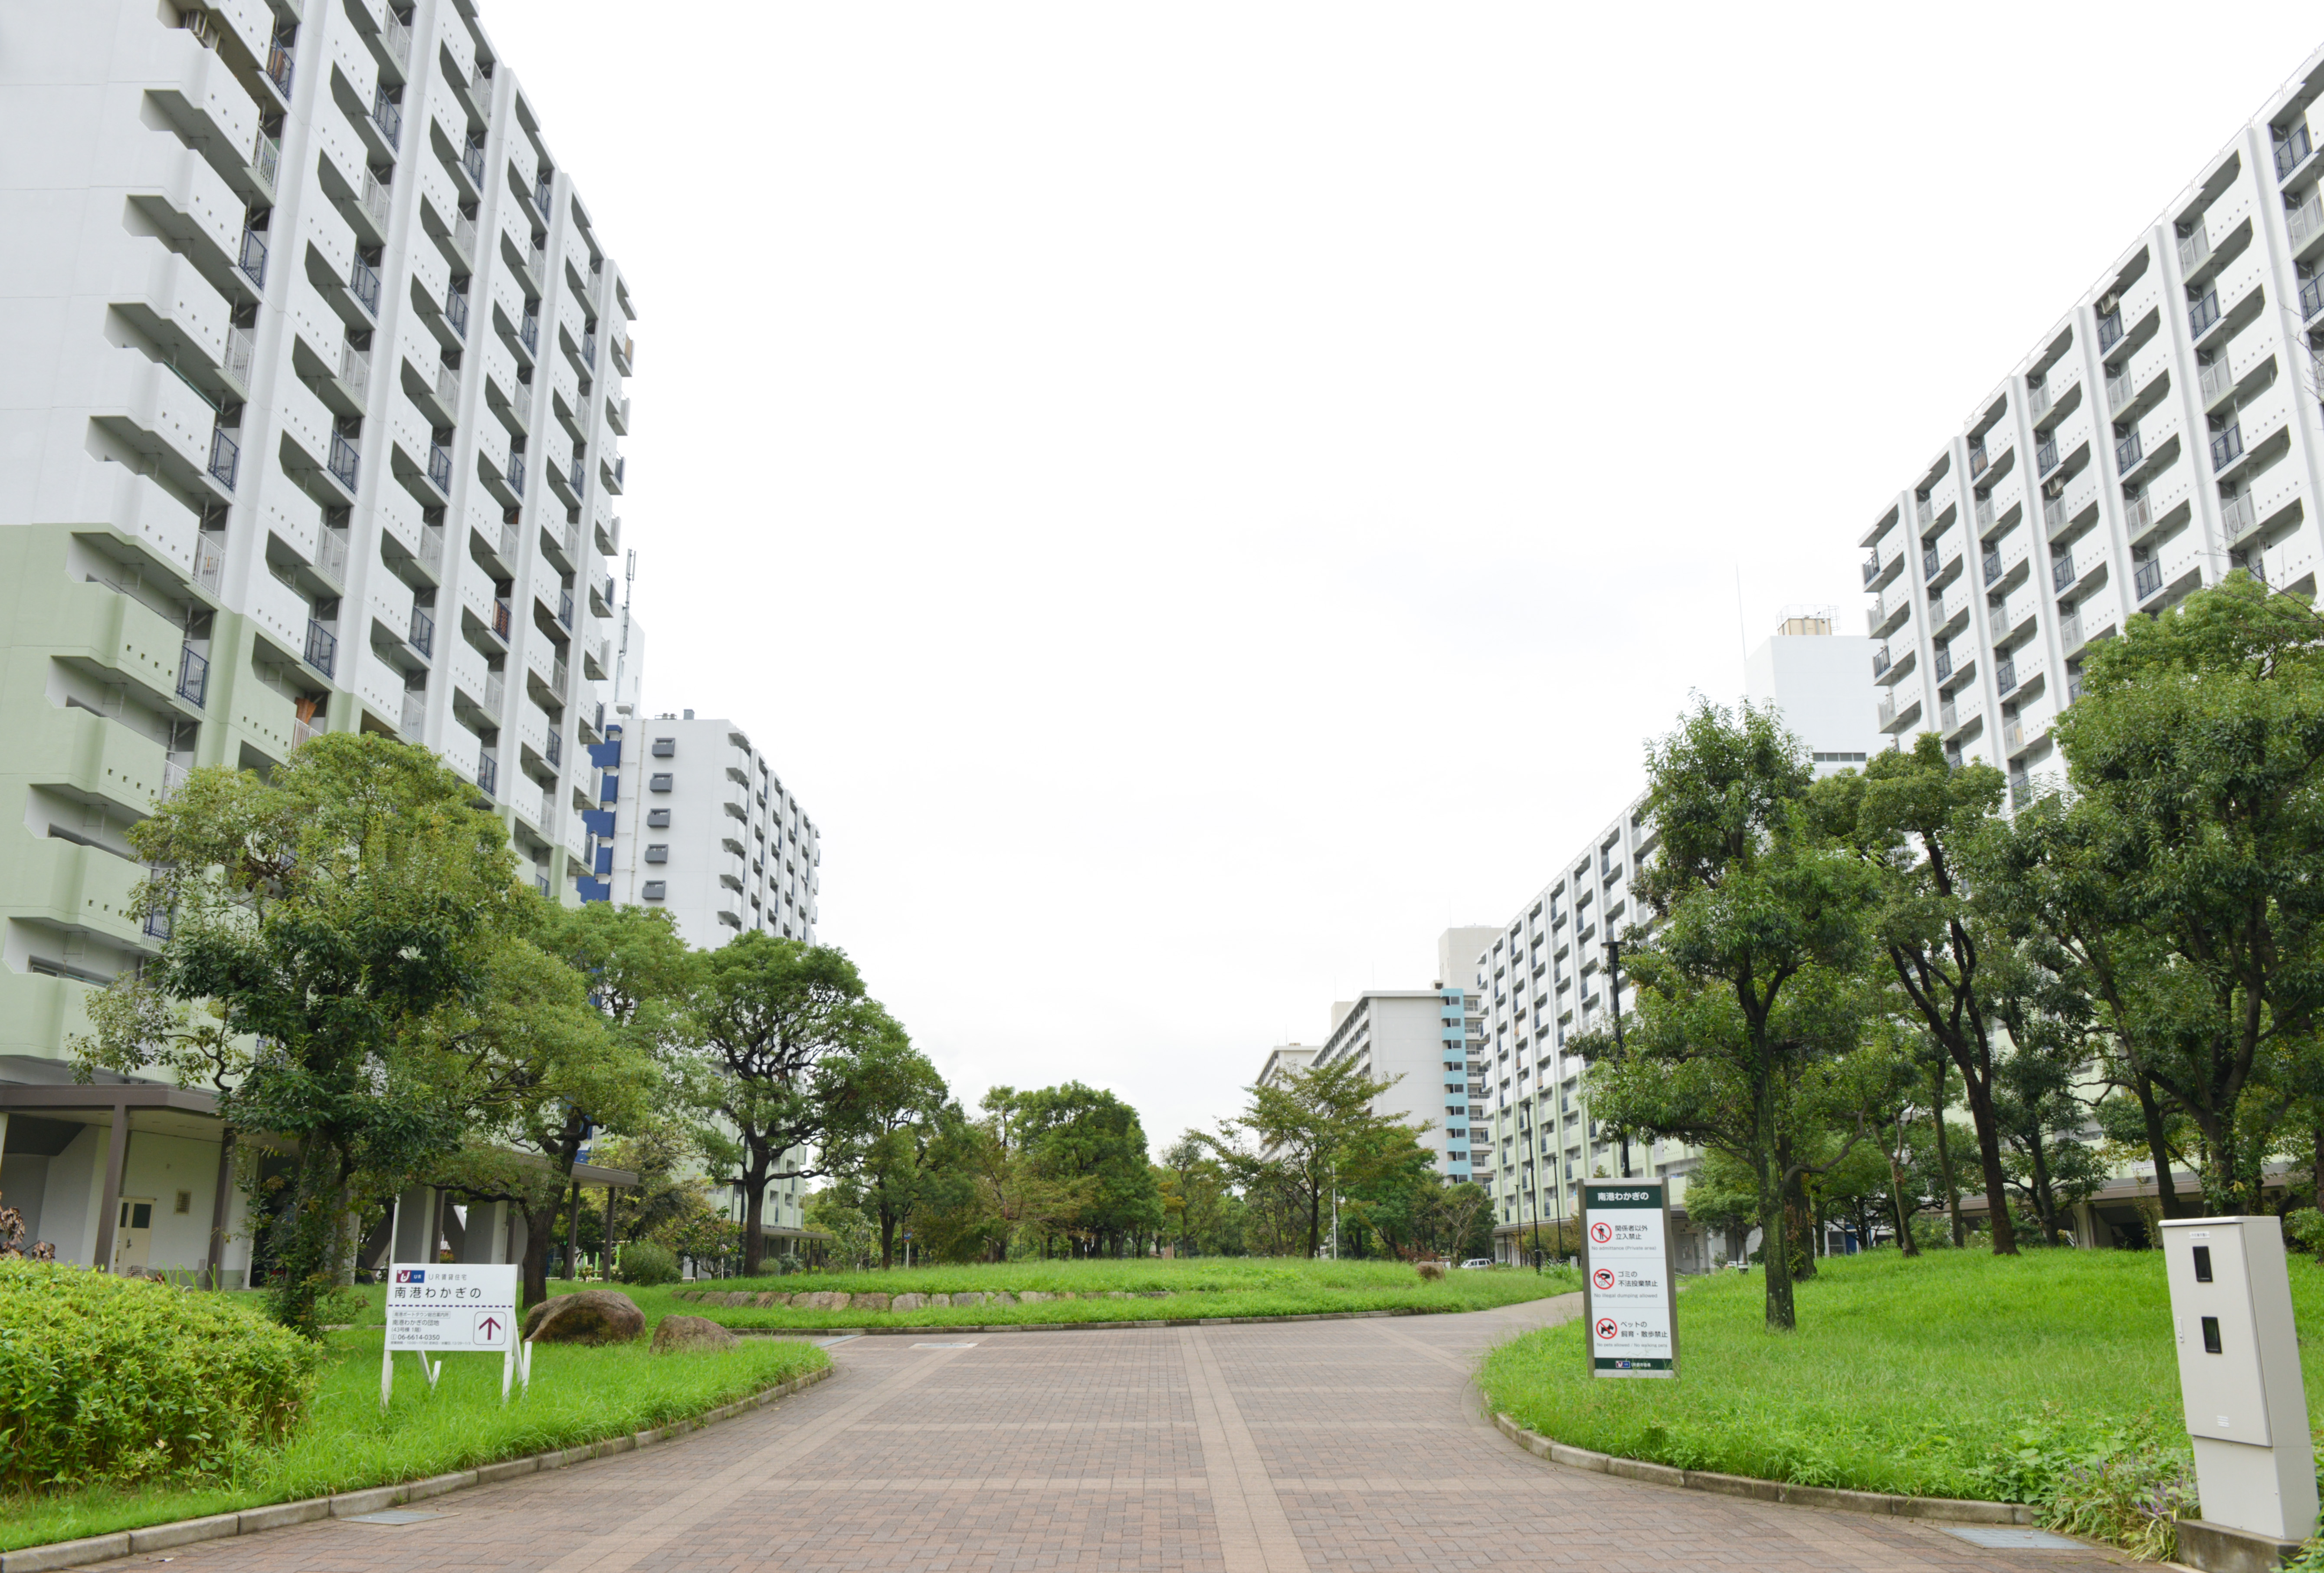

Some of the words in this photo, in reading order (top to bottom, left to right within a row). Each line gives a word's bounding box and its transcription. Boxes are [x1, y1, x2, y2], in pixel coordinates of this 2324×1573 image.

[1597, 1192, 1649, 1201] 南港わかぎの
[395, 1287, 481, 1298] 南港わかぎの
